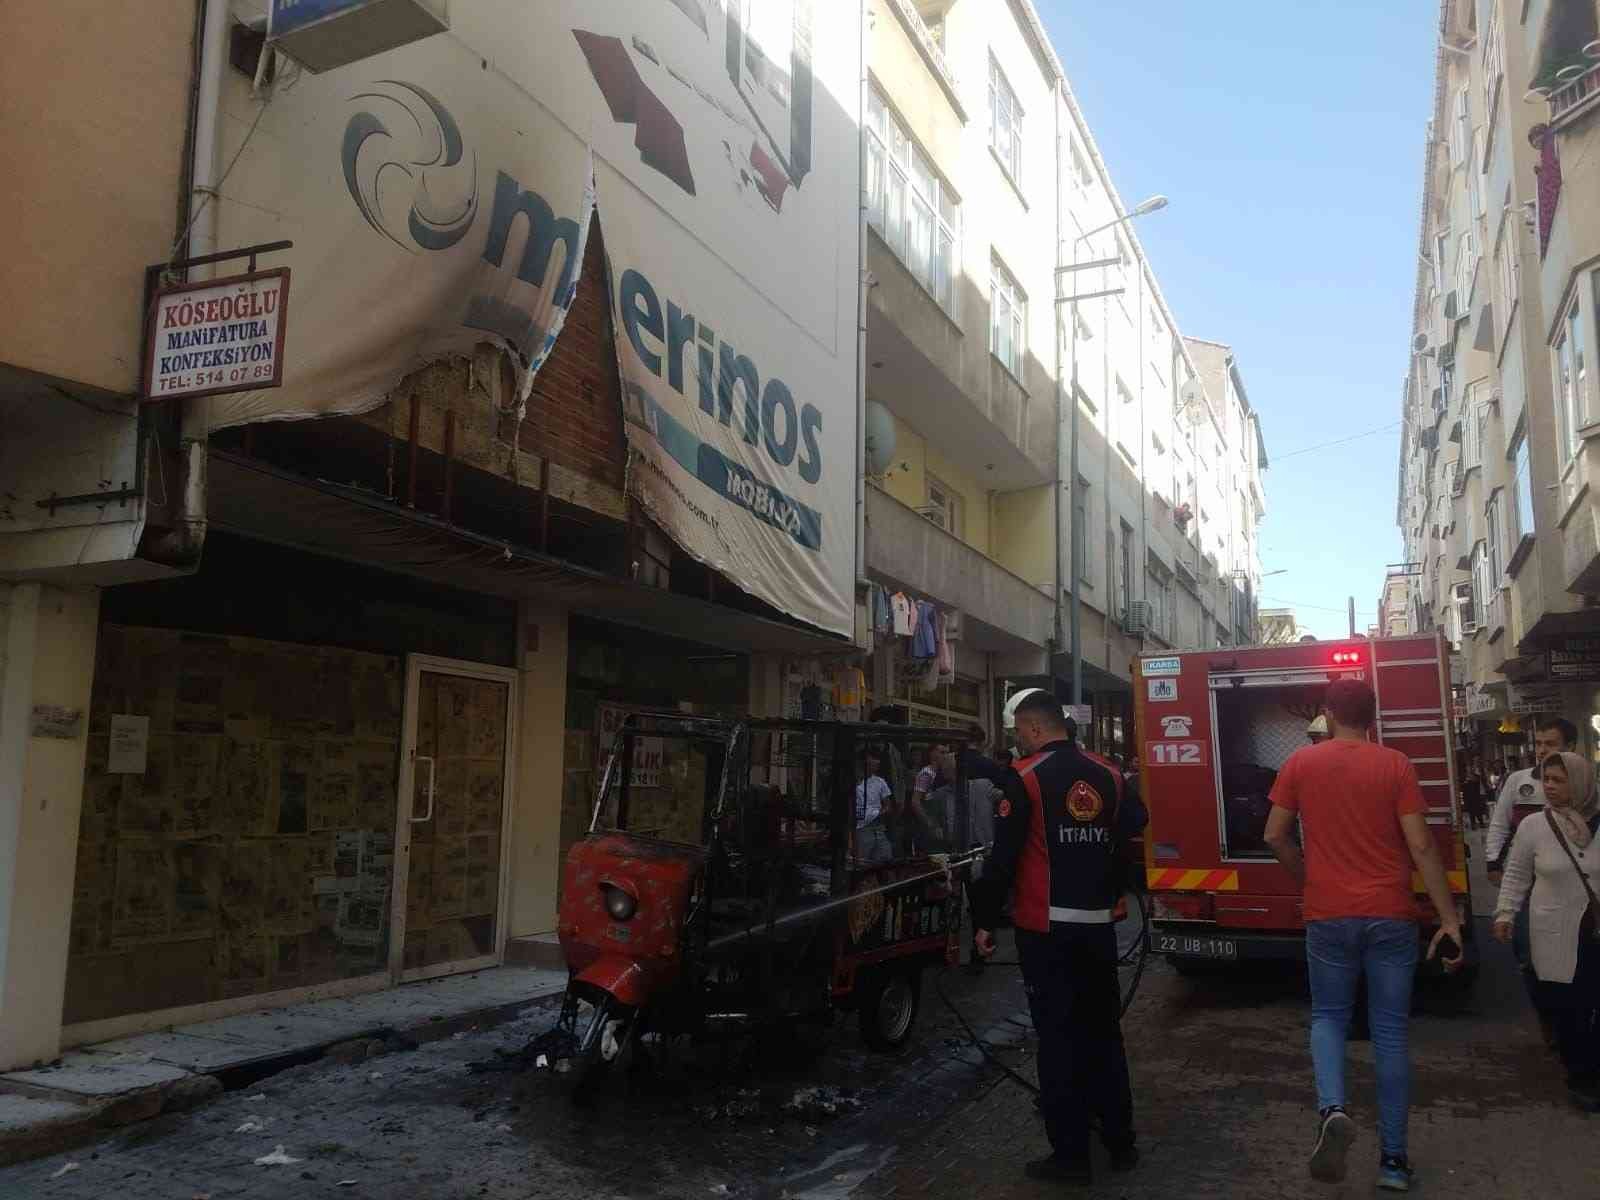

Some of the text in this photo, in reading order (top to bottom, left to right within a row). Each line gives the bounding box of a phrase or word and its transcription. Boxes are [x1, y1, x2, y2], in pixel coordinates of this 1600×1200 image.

[163, 288, 279, 329] KÖSEOĞLU
[160, 364, 273, 391] TEL: 514 07 89
[1152, 744, 1201, 763] 112
[1160, 937, 1234, 955] 22 UB 110
